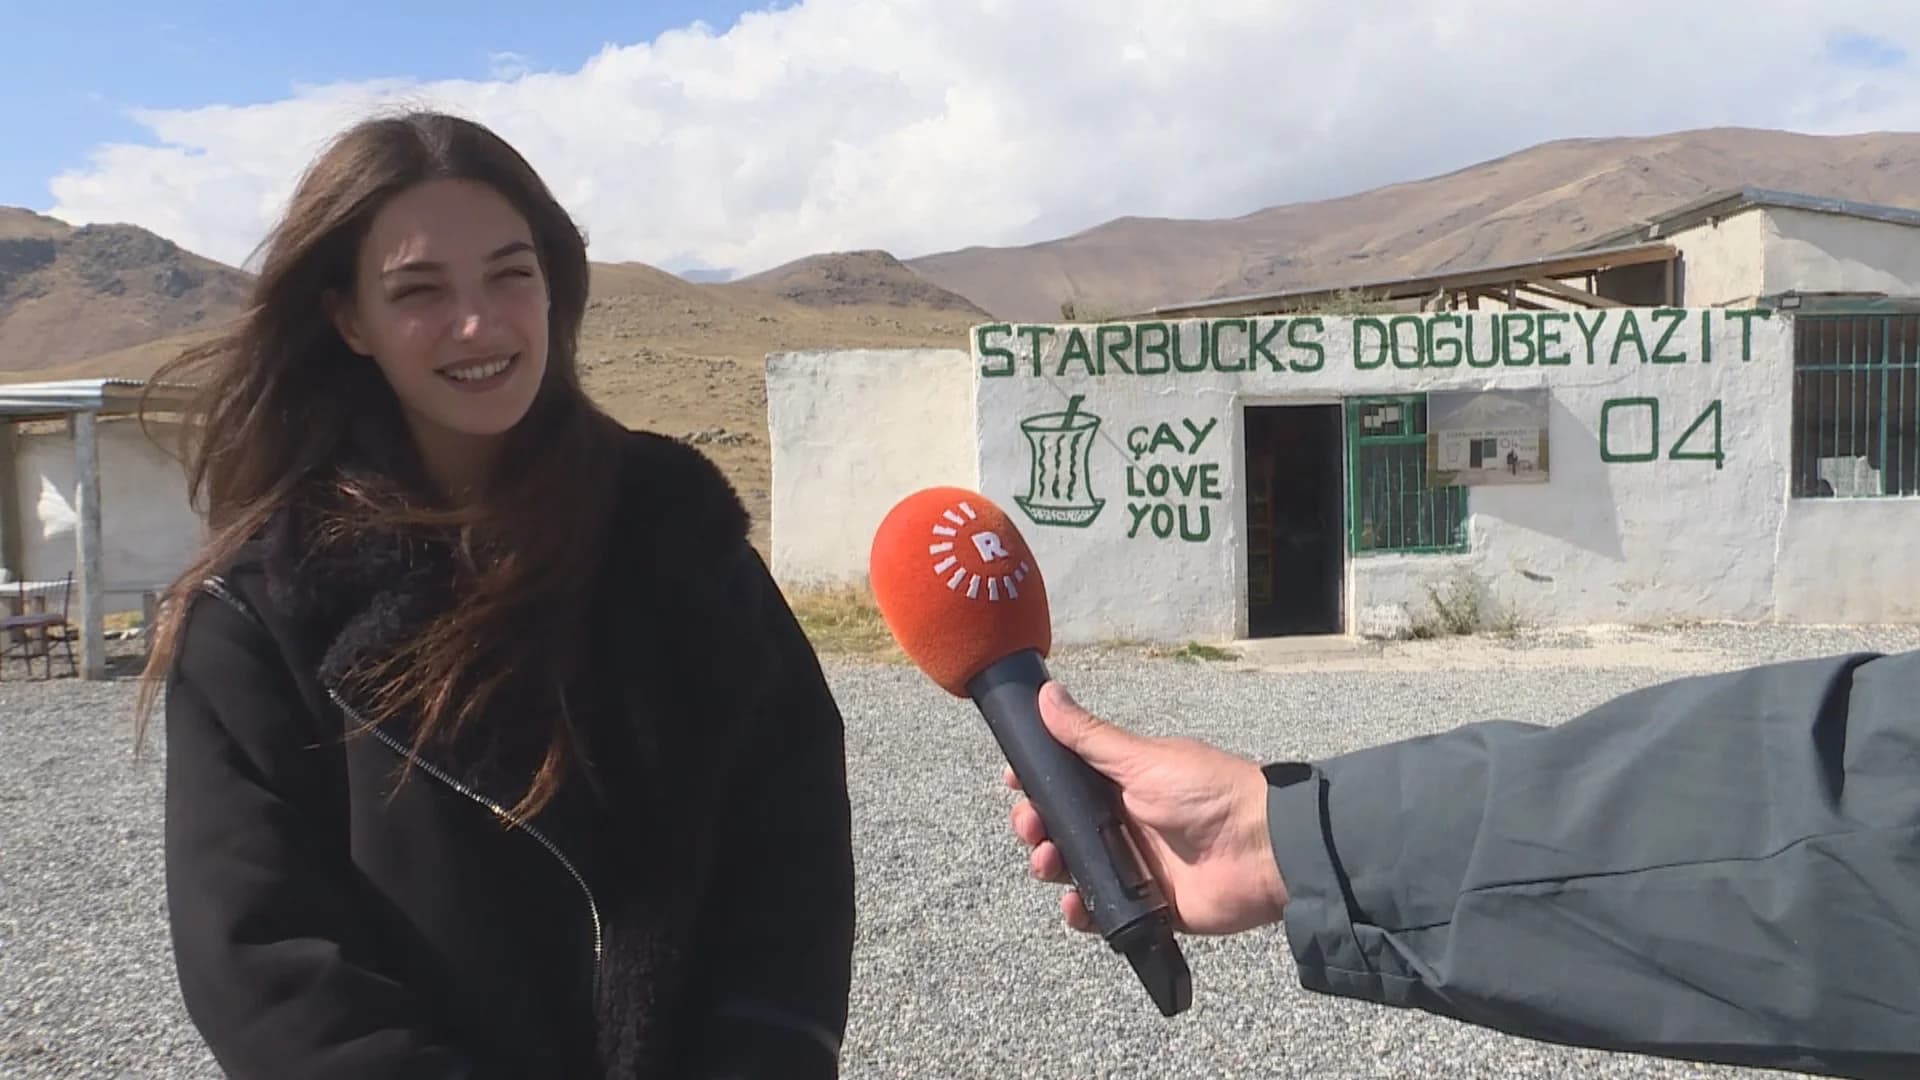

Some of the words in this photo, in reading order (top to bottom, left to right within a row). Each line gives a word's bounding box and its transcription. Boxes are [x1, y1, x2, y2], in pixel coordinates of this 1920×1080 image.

[977, 317, 1325, 377] STARBUCKS
[1127, 417, 1217, 460] ÇAY
[1600, 396, 1725, 469] 04
[1127, 463, 1222, 500] LOVE
[1127, 502, 1211, 542] YOU
[971, 531, 1008, 563] R
